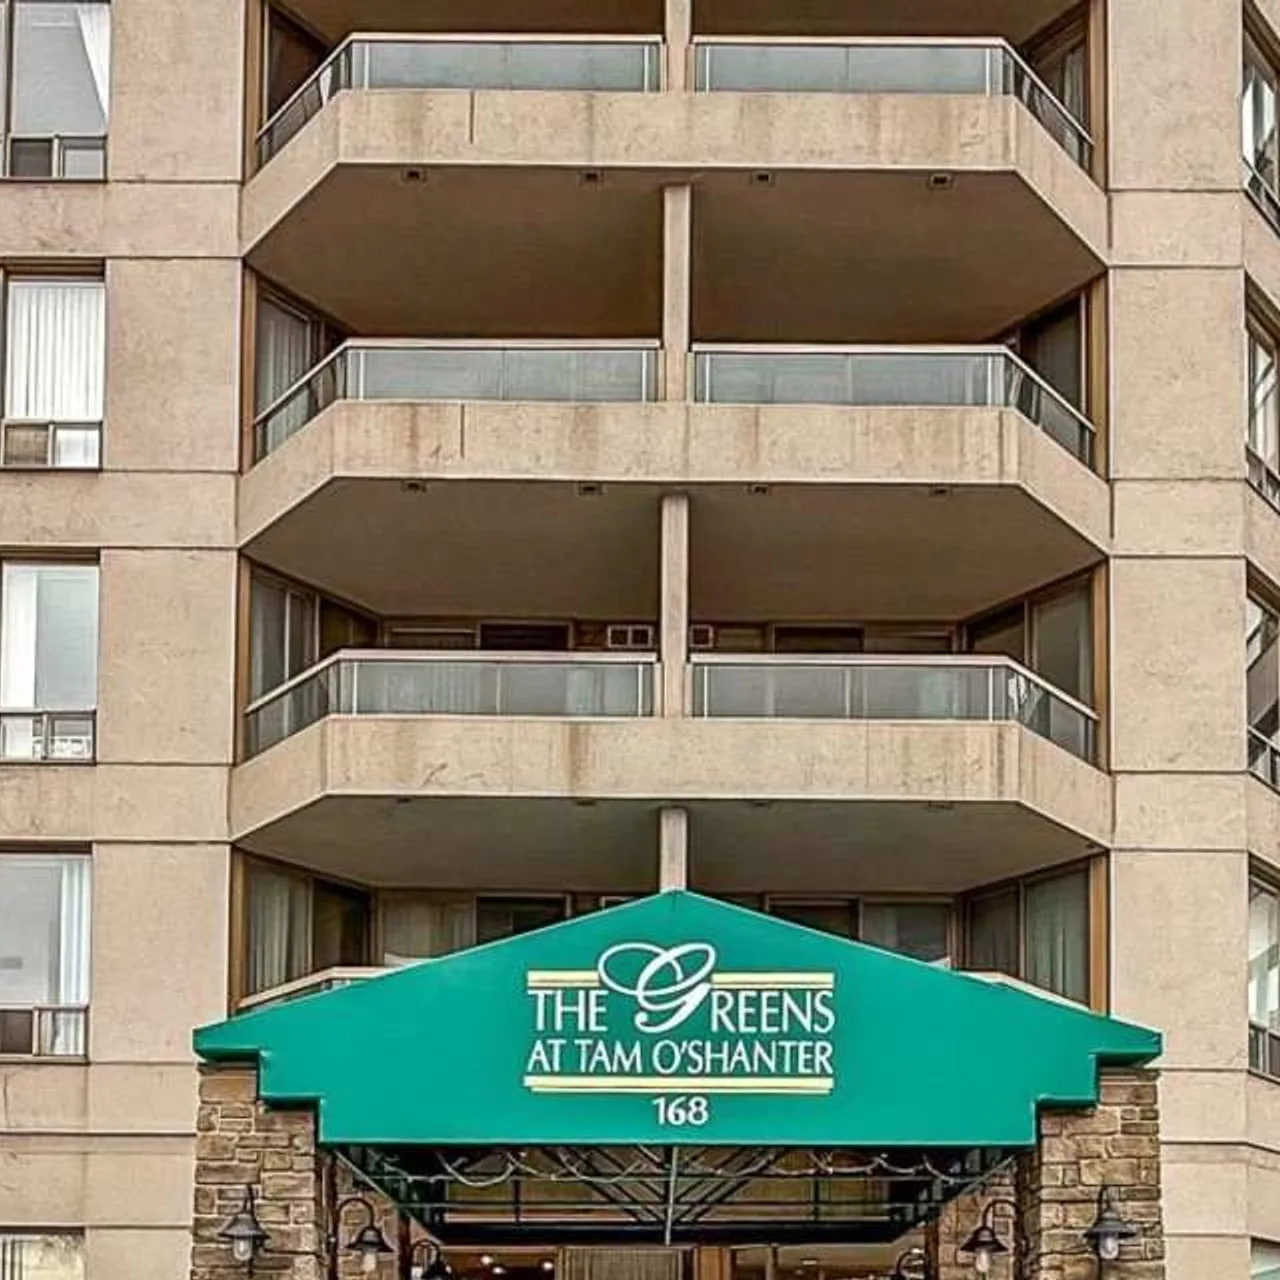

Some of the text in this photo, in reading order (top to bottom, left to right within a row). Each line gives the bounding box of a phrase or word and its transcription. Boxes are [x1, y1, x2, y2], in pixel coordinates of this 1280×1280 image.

[526, 942, 836, 1033] THE GREENS
[526, 1038, 834, 1075] AT TAM O'SHANTER
[652, 1096, 709, 1126] 168
